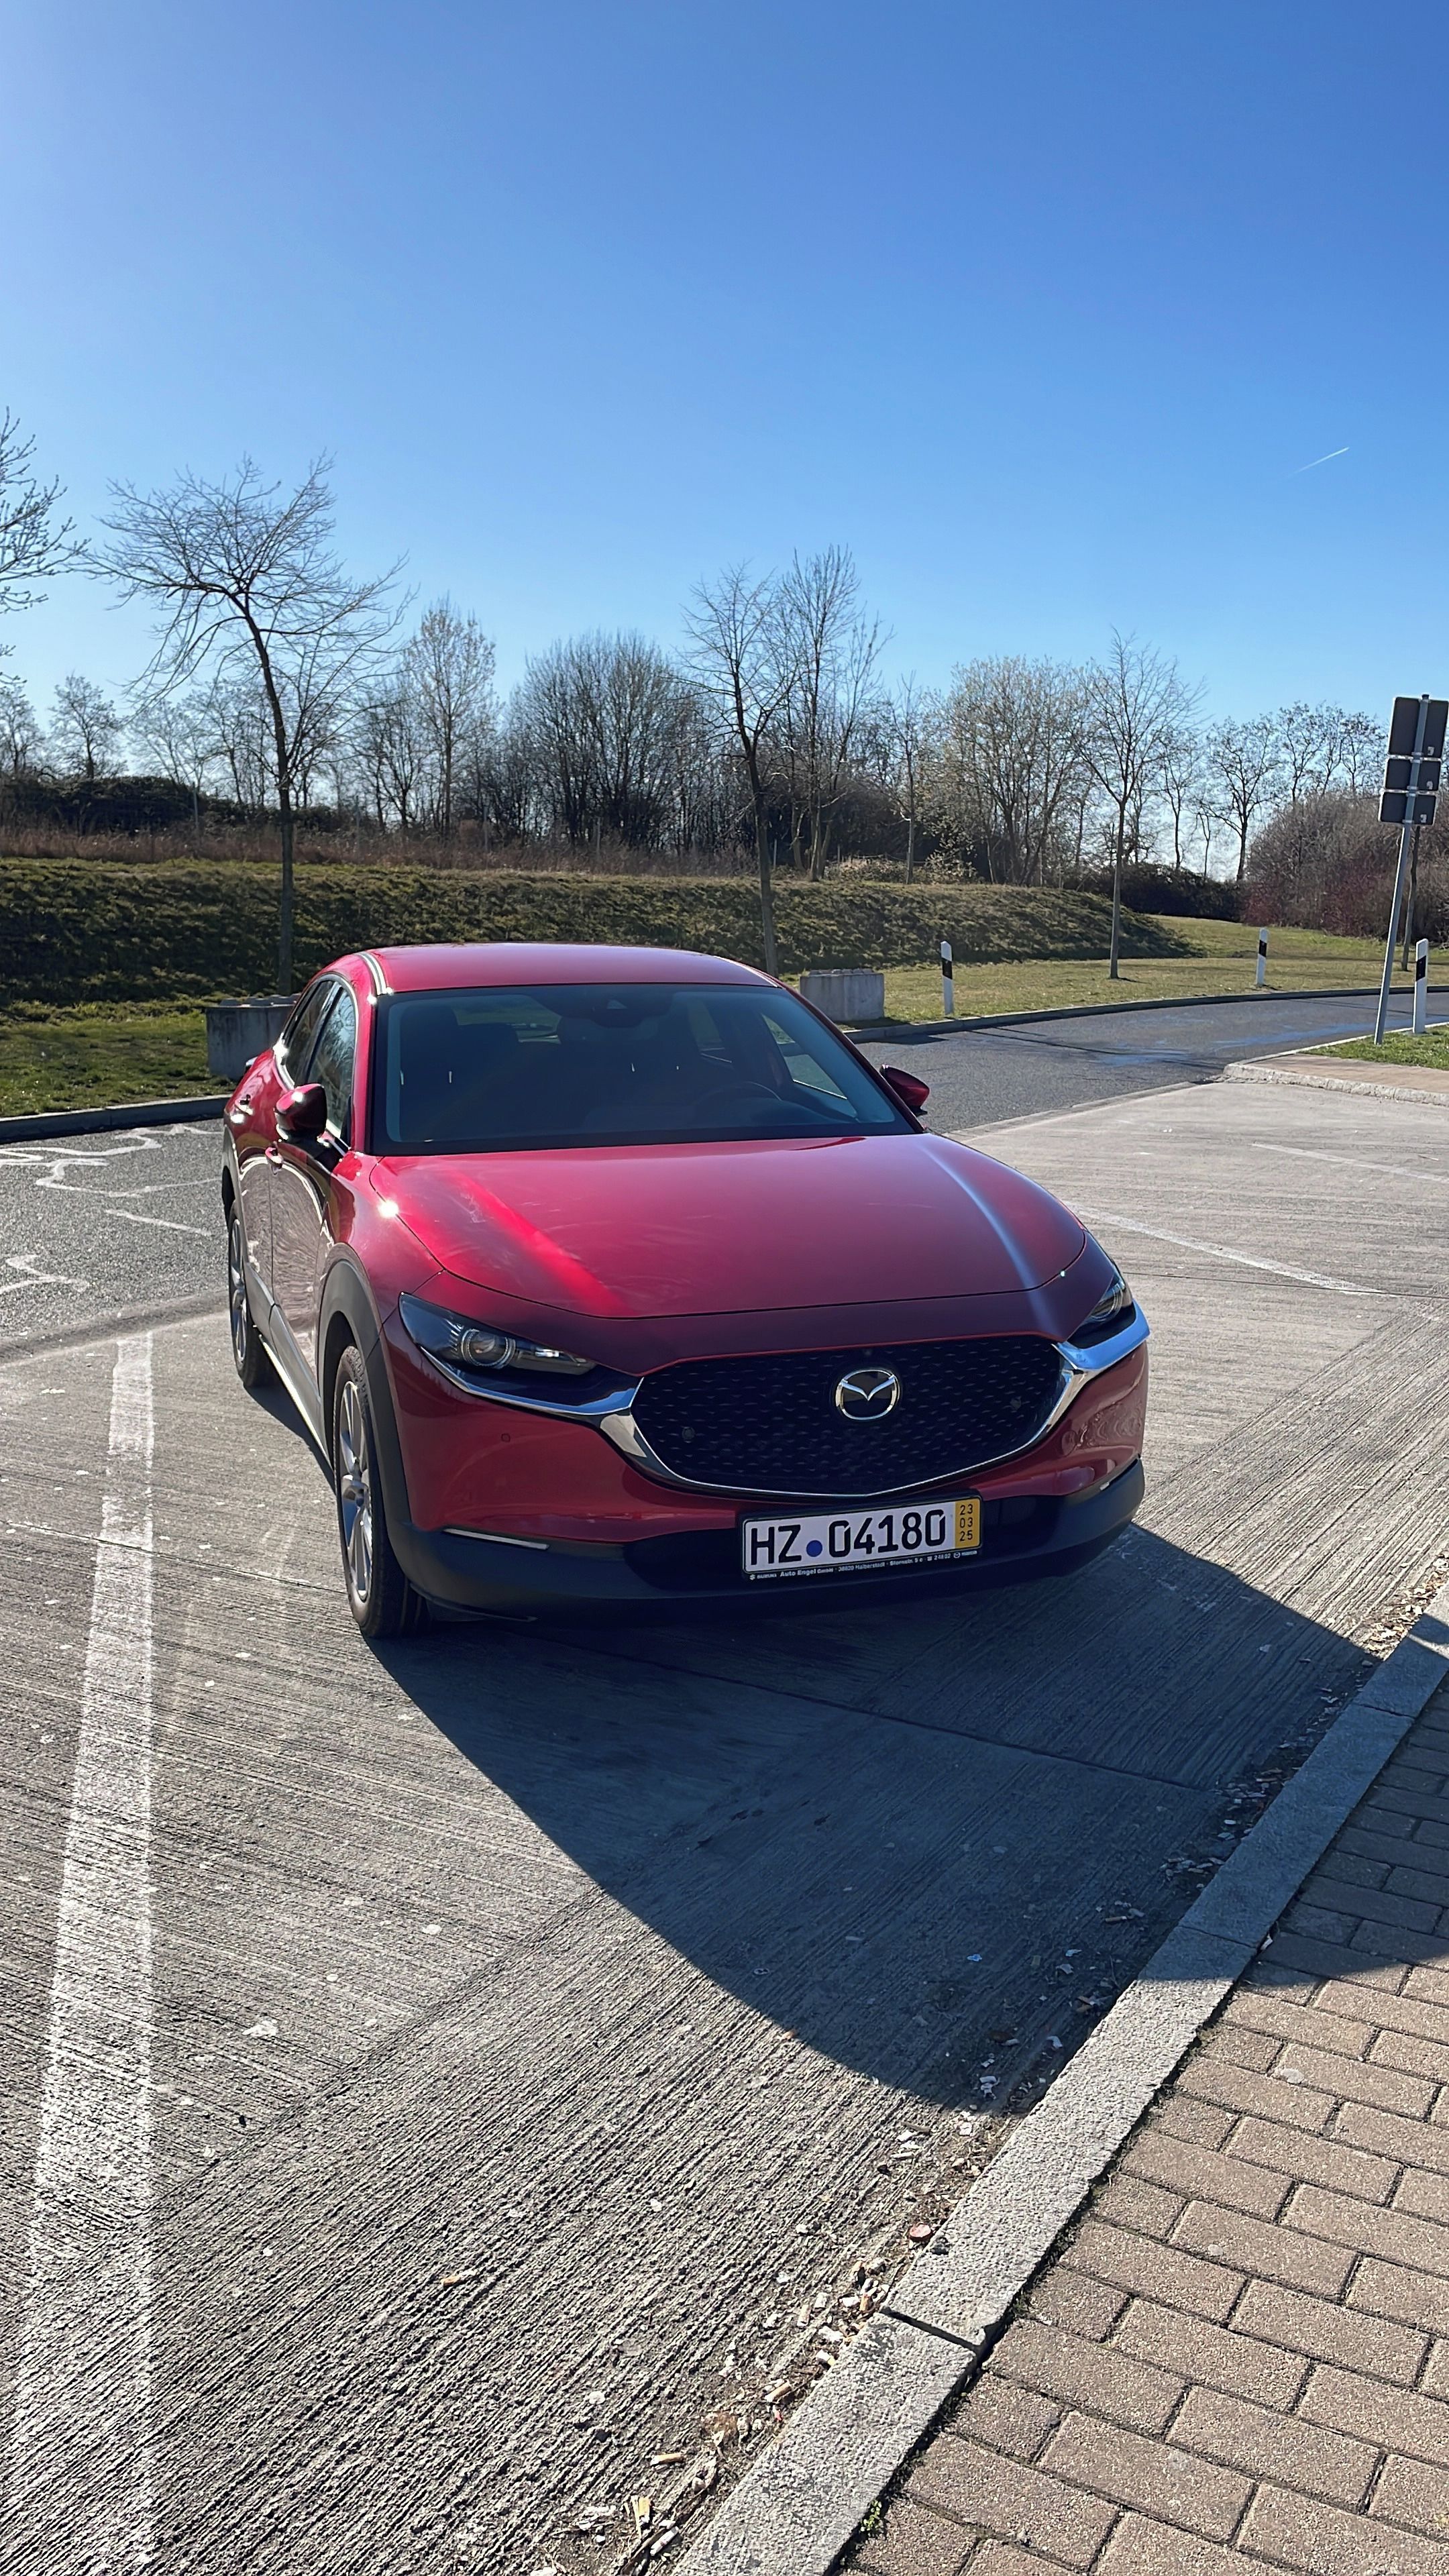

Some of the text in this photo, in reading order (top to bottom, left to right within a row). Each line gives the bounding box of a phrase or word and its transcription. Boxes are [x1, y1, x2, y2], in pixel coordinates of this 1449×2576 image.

[959, 1503, 973, 1515] 23
[959, 1517, 973, 1528] 03
[751, 1509, 945, 1566] HZ 04180
[959, 1529, 973, 1542] 25
